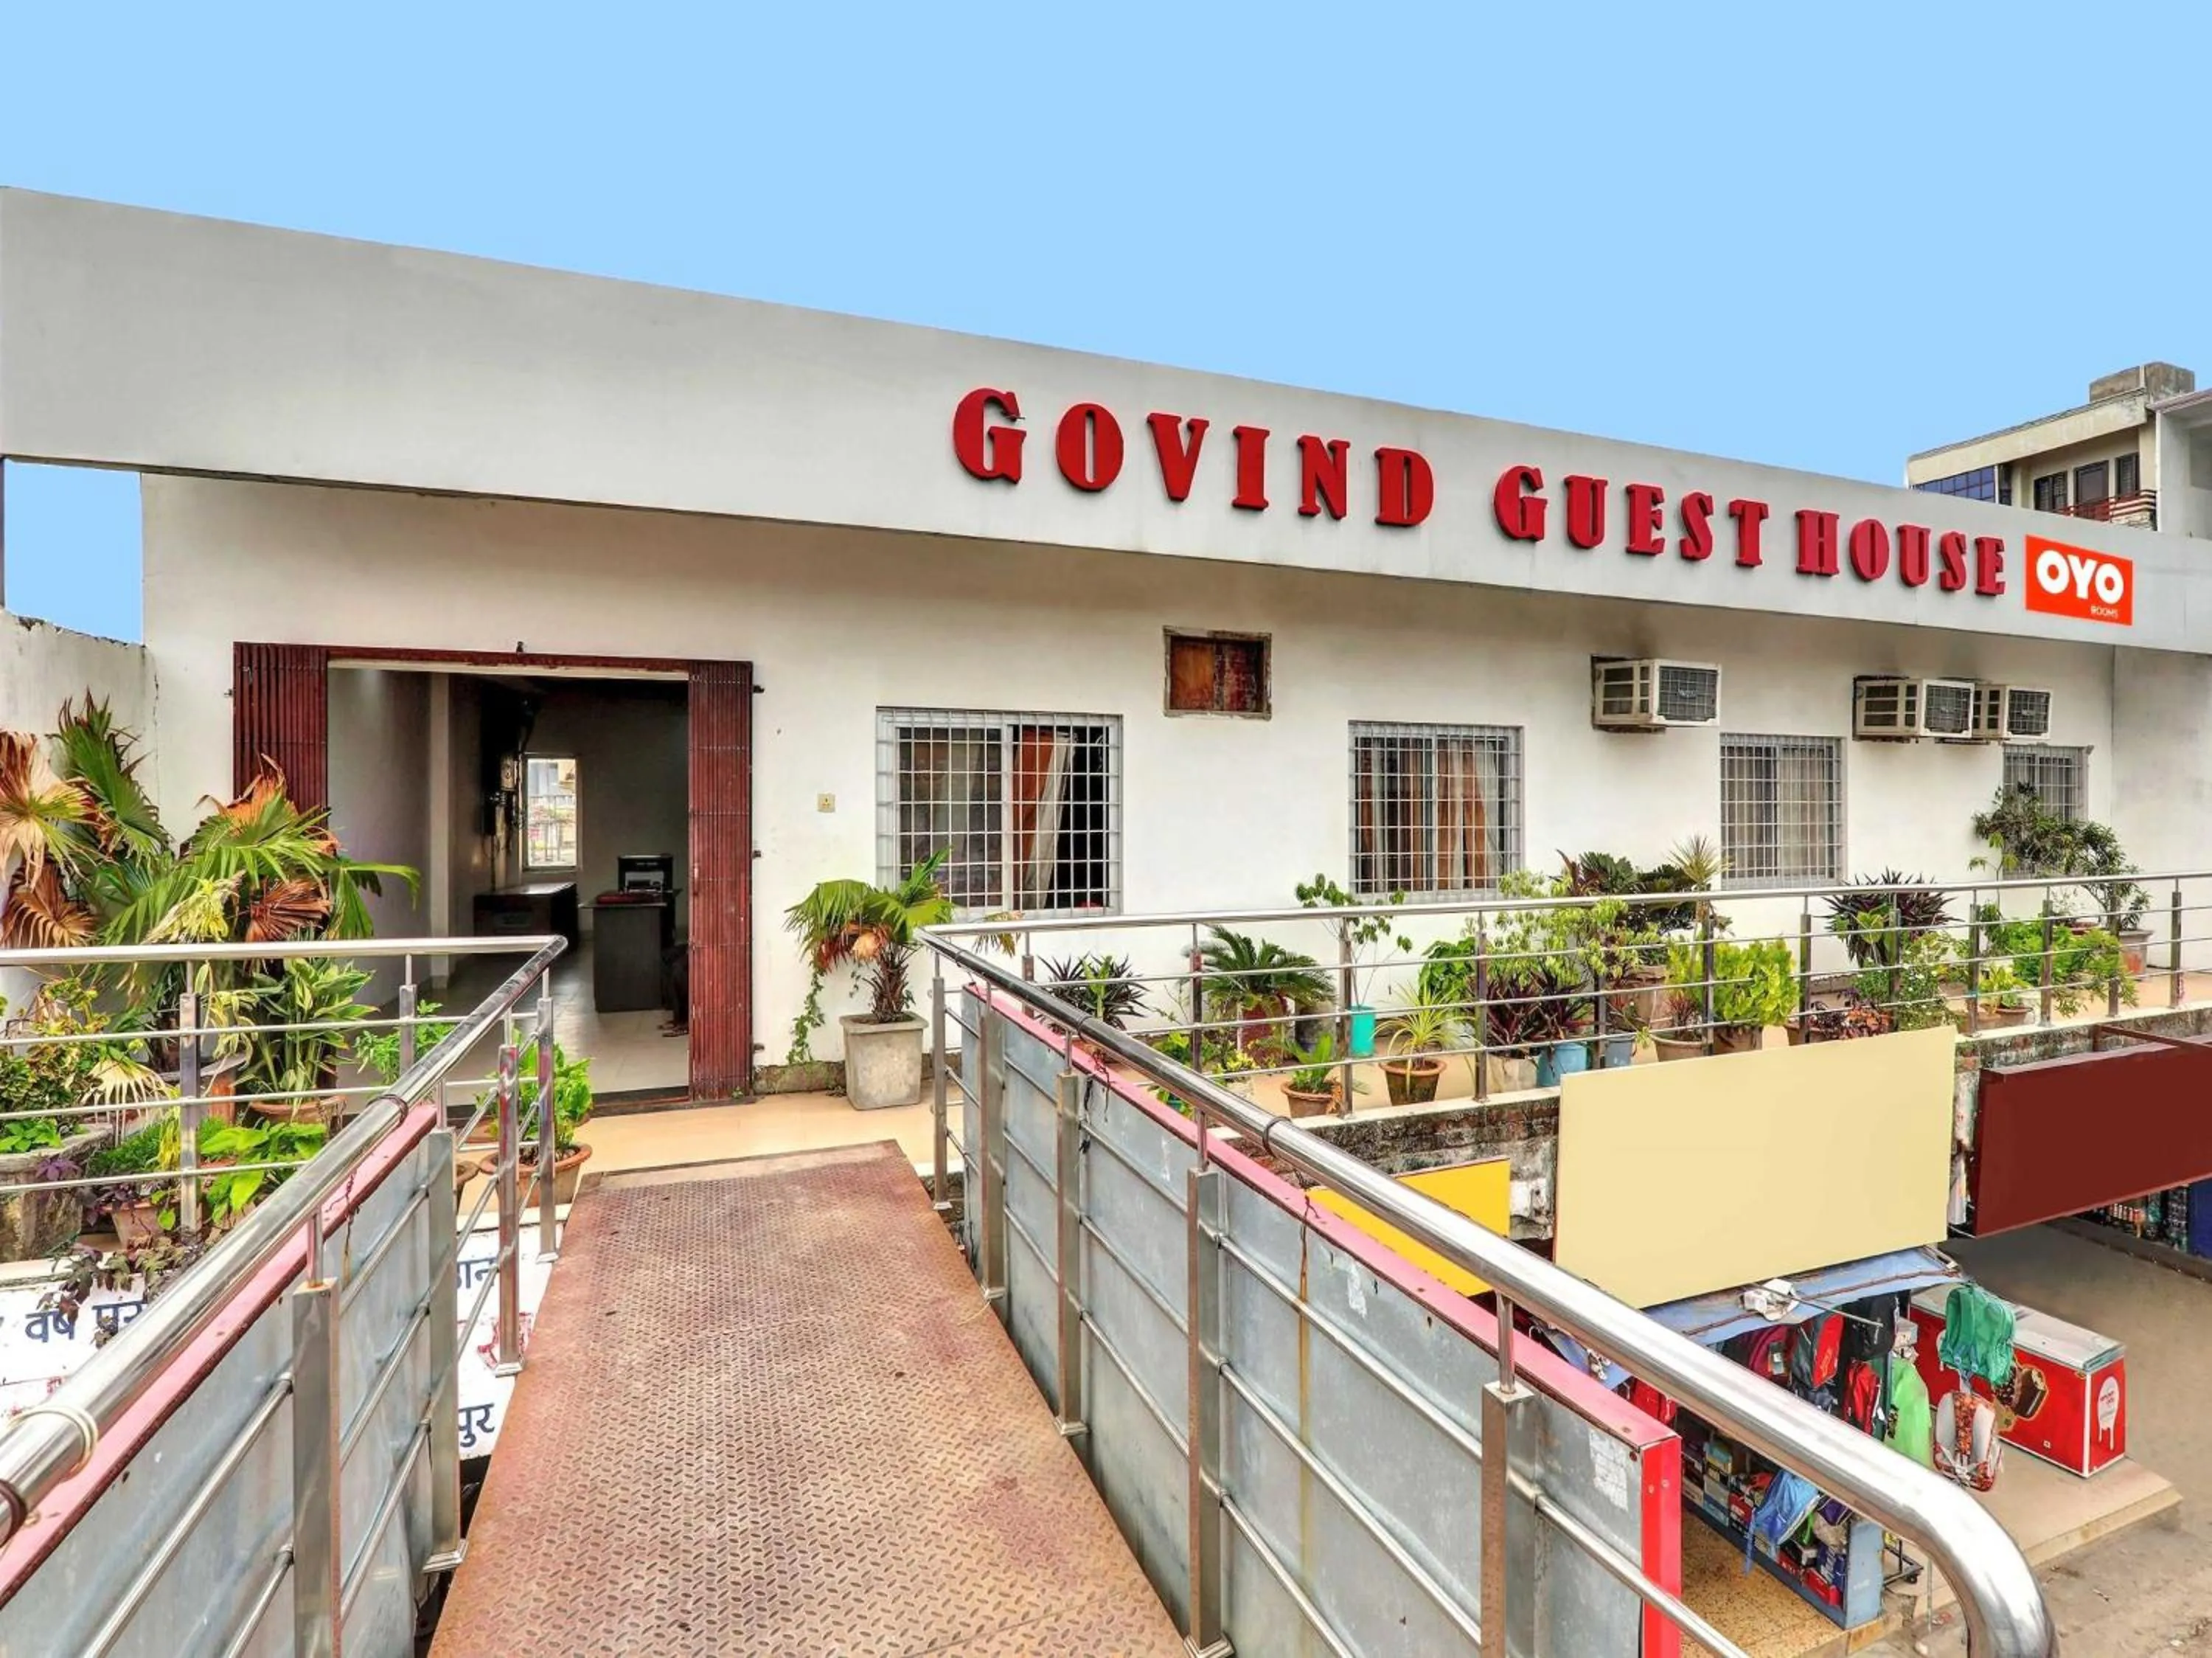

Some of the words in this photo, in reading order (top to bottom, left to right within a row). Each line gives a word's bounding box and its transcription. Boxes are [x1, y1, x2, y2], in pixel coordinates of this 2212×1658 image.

[952, 387, 1435, 527] GOVIND
[1493, 465, 1770, 566] GUEST
[1797, 510, 2006, 595] HOUSE
[2037, 549, 2124, 604] OYO
